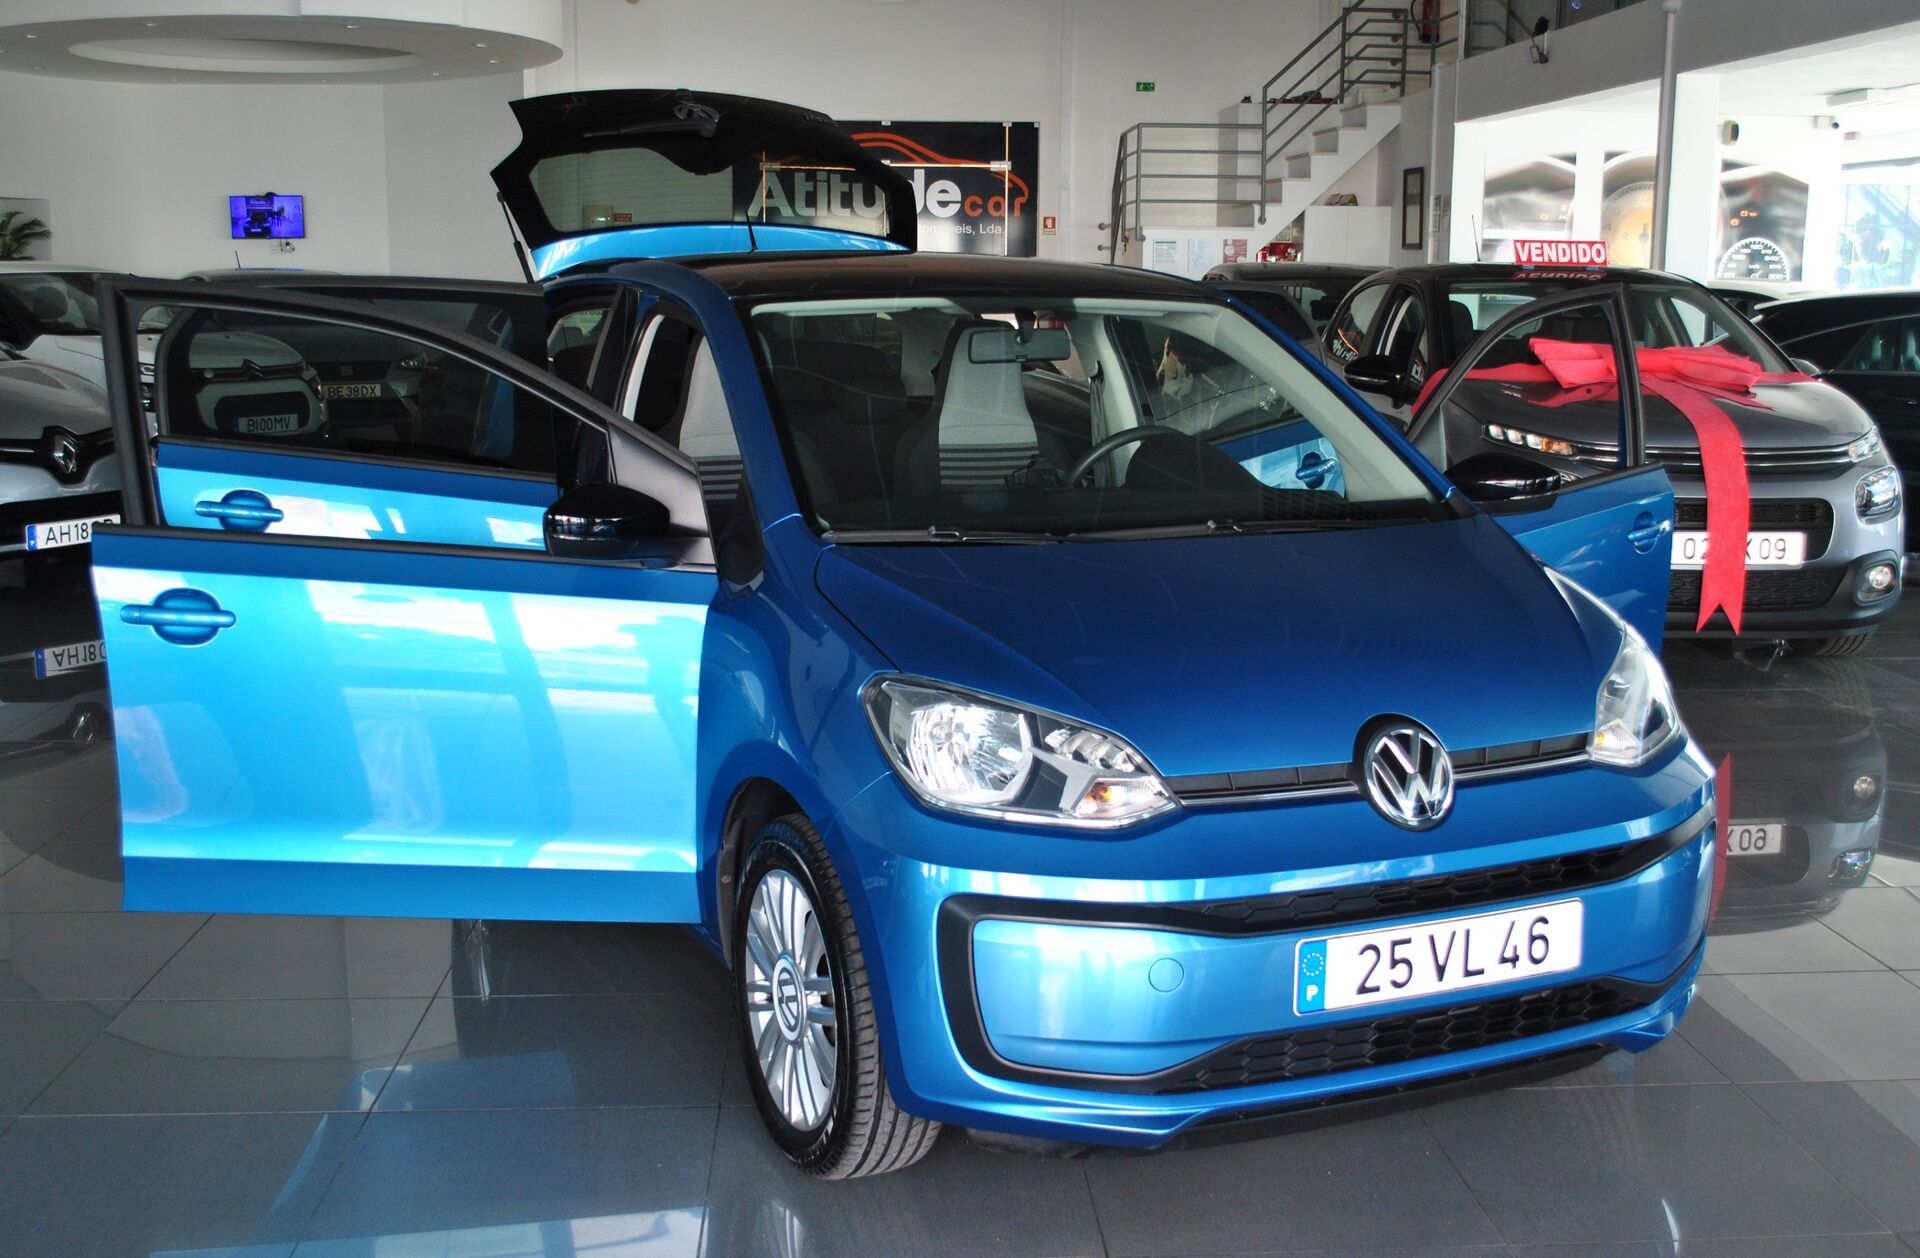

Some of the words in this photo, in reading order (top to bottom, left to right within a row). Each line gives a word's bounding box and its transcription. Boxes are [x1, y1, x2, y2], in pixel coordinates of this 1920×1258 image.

[980, 223, 1005, 234] Lda.
[1515, 242, 1606, 263] VENDIDO
[1759, 537, 1786, 560] 09
[1306, 984, 1318, 1001] P
[1356, 937, 1413, 995] 25
[1428, 928, 1485, 983] VL
[1498, 915, 1550, 969] 46
